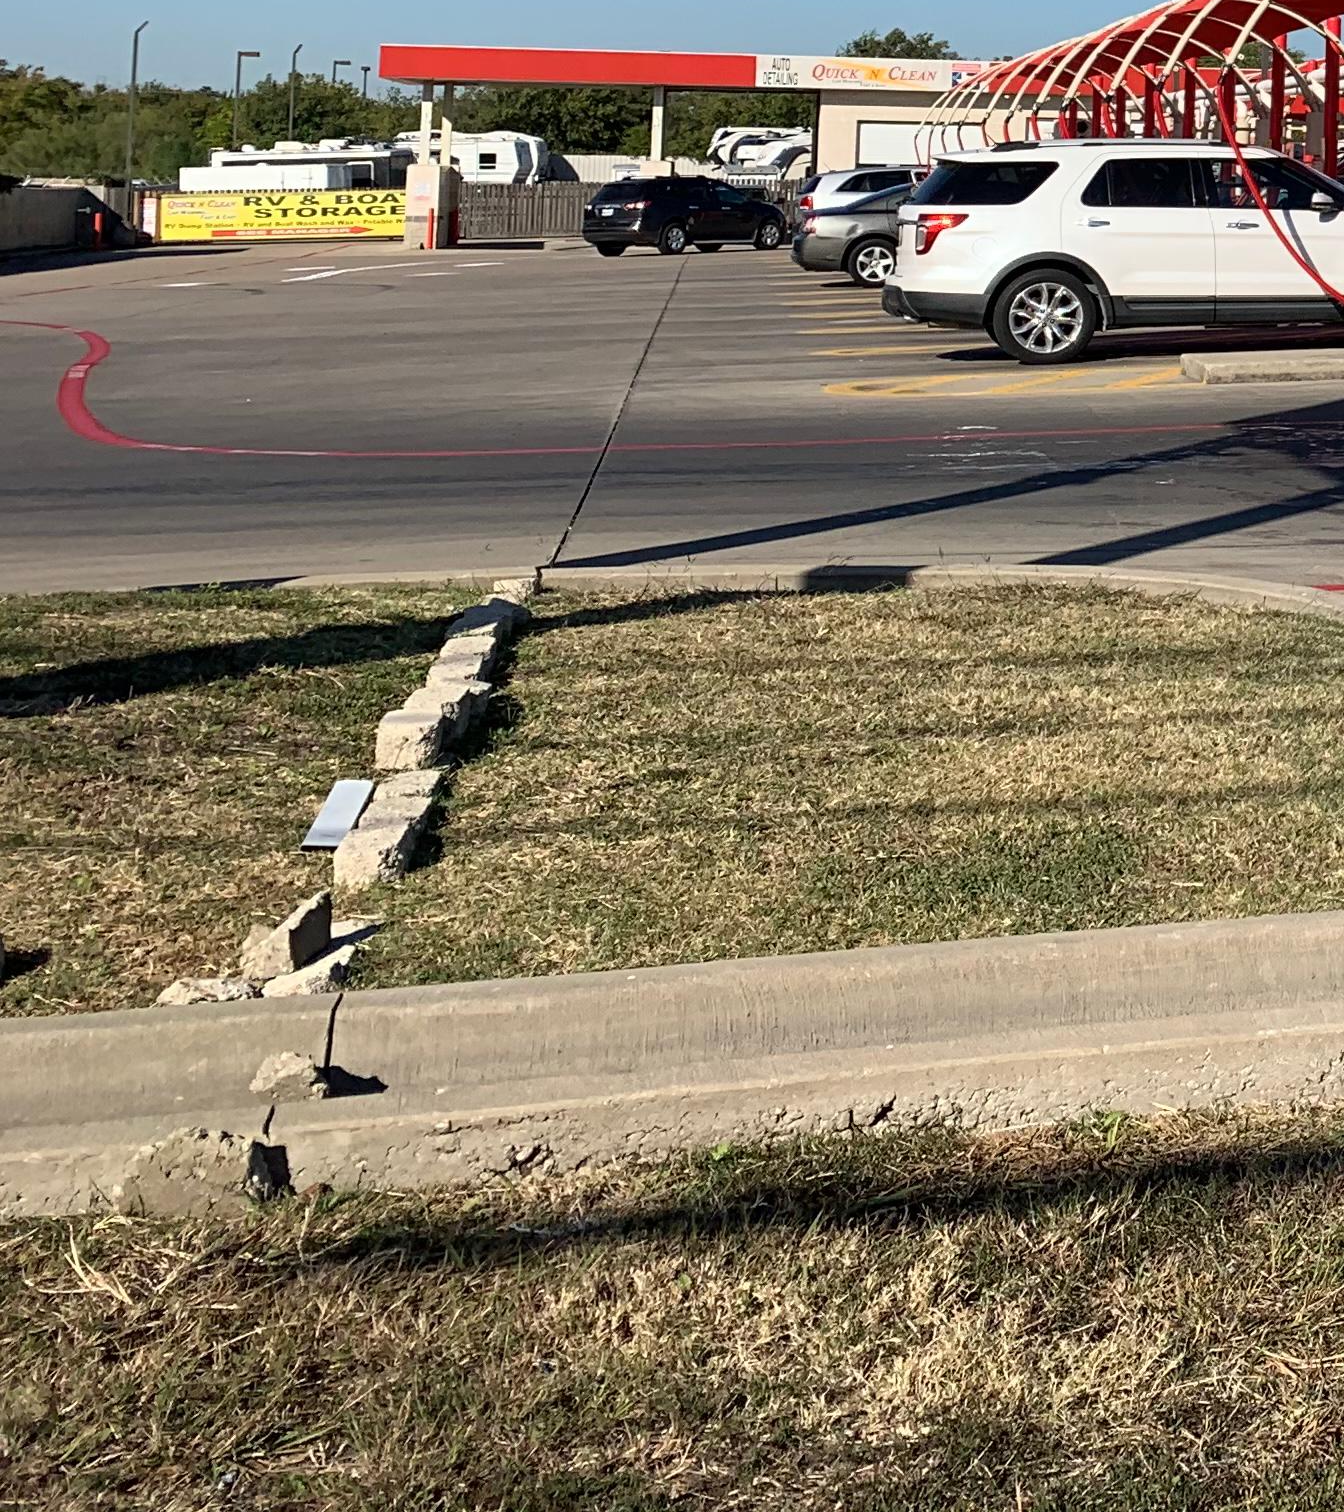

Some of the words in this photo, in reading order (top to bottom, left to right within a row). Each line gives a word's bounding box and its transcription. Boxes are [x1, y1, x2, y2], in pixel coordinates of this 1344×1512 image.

[771, 58, 791, 70] AUTO
[762, 72, 799, 86] DETAILING
[812, 64, 859, 82] QUICK
[869, 68, 881, 80] N
[888, 66, 937, 81] CLEAN
[243, 196, 286, 207] RV
[300, 195, 319, 206] &
[254, 205, 406, 219] STORAGE
